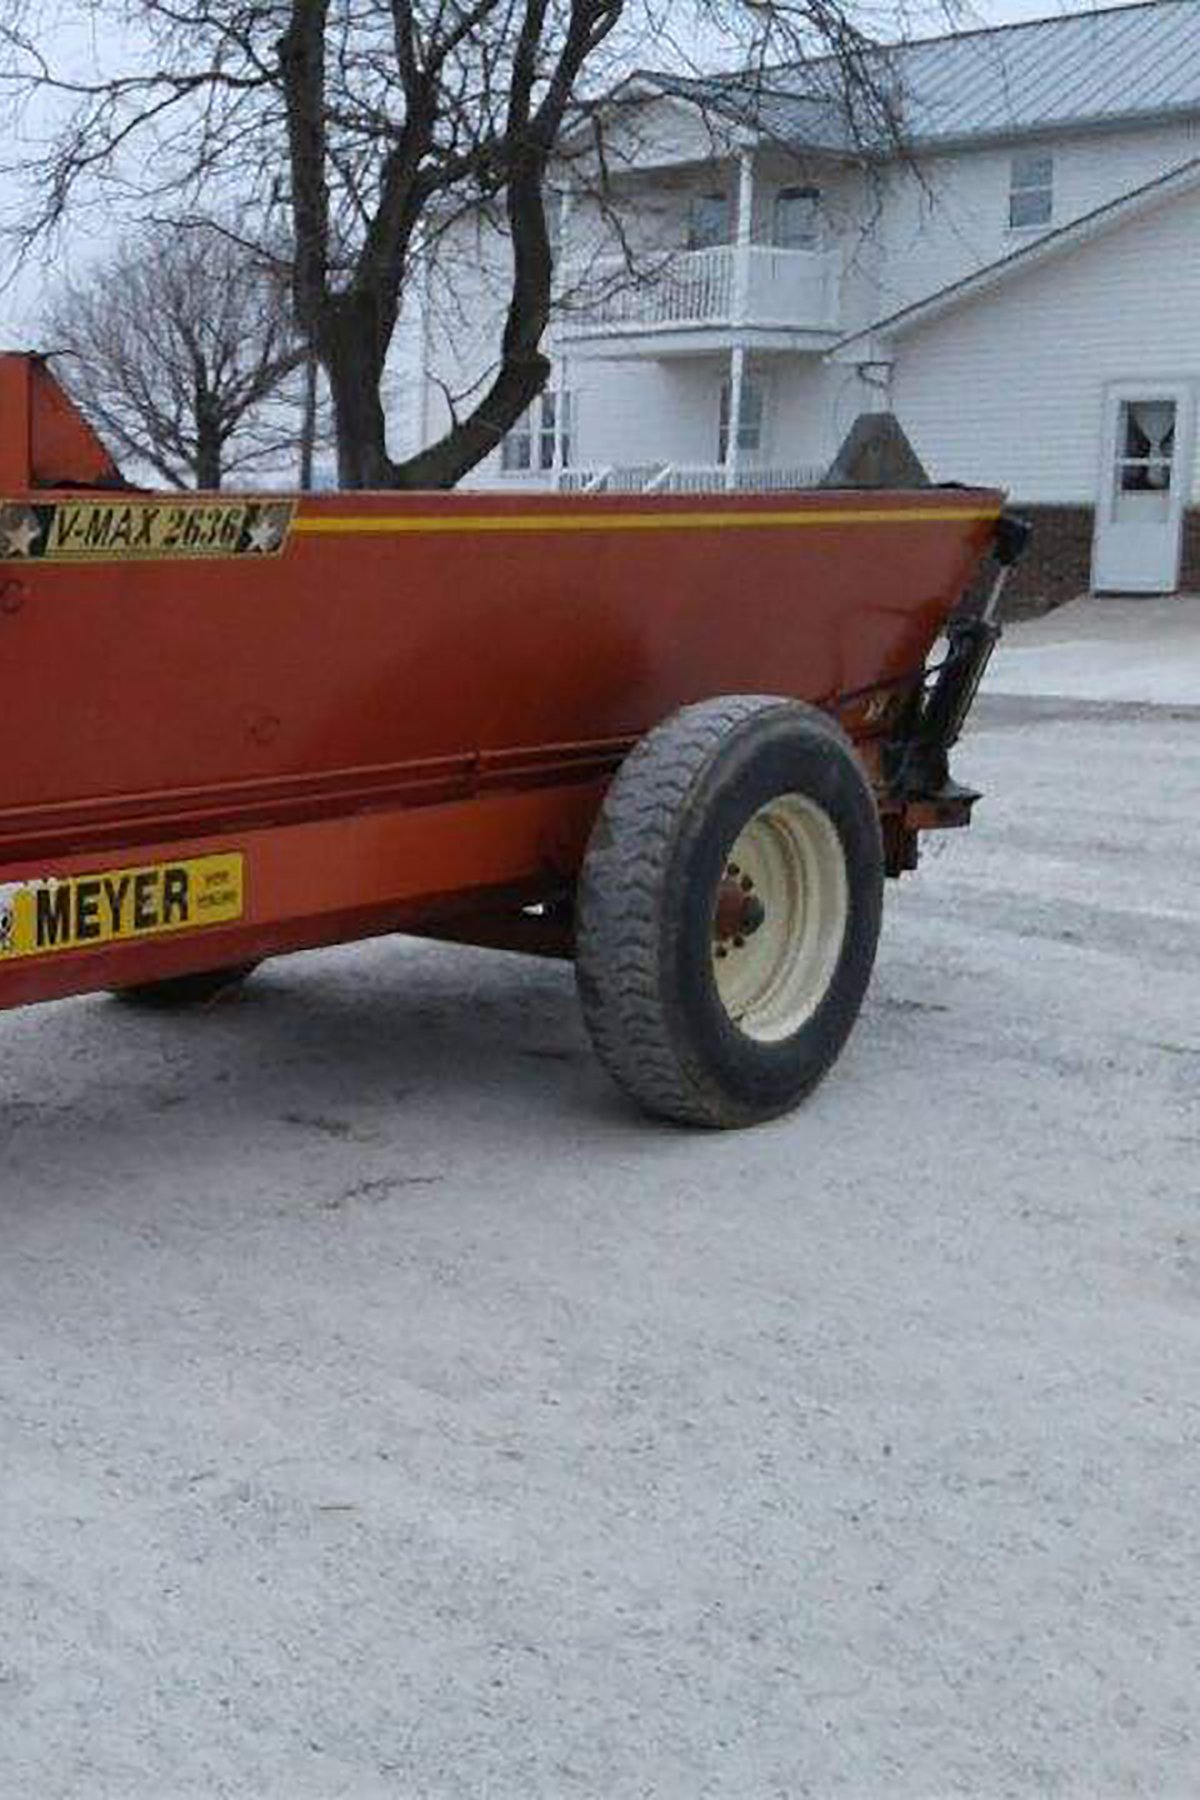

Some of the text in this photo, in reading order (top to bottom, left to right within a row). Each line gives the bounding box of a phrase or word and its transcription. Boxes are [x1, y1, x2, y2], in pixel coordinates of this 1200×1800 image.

[57, 507, 241, 546] V-MAX 2636
[36, 869, 188, 947] MEYER
